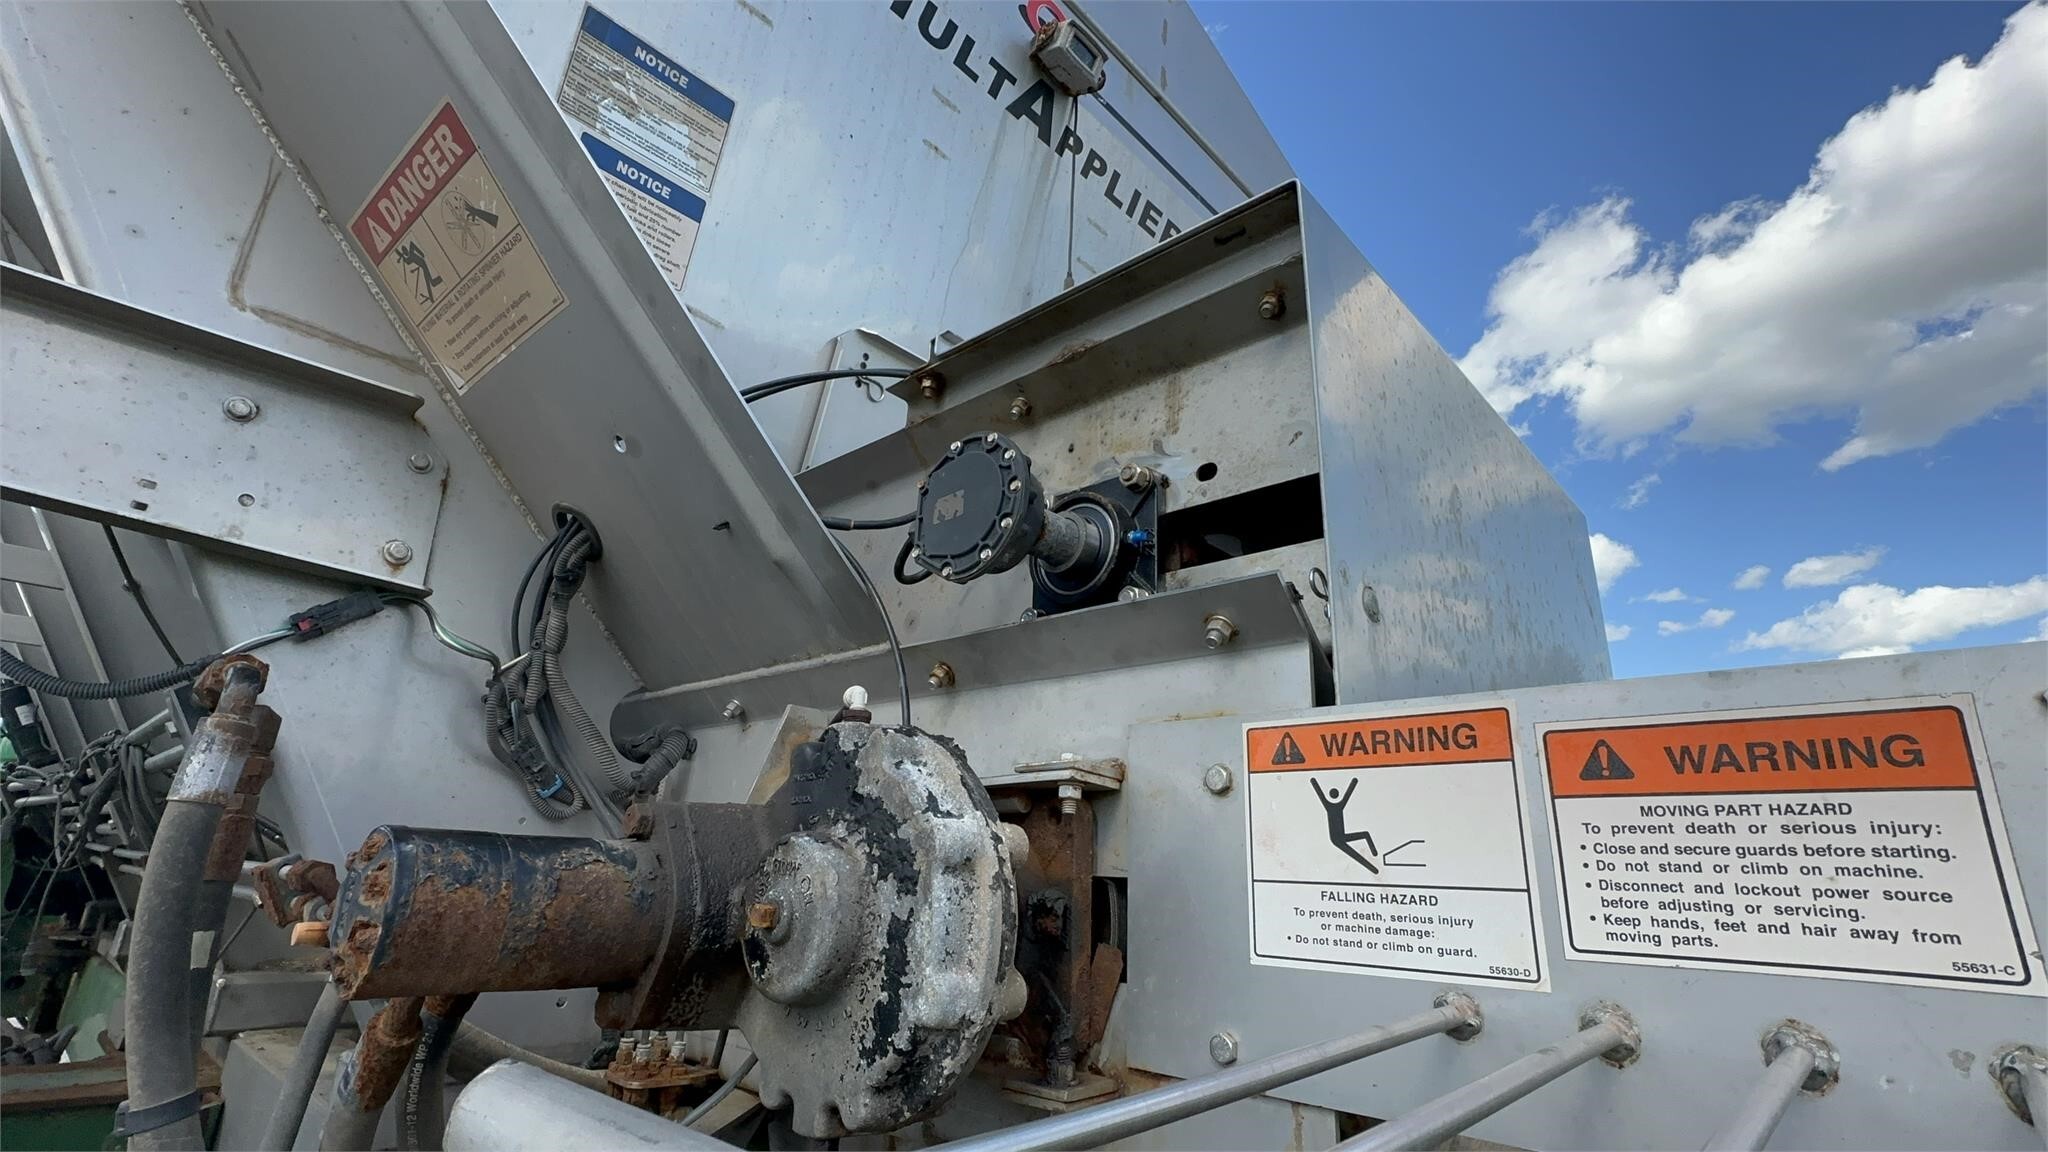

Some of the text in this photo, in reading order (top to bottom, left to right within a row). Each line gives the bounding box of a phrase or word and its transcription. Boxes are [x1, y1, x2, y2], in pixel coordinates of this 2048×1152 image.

[634, 46, 688, 88] NOTICE
[378, 124, 462, 231] DANGER
[615, 160, 670, 198] NOTICE
[611, 180, 626, 191] chain
[626, 188, 636, 197] life
[615, 191, 637, 205] periodic
[637, 211, 648, 219] and
[646, 224, 657, 233] and
[457, 273, 480, 297] ROTATING
[479, 253, 500, 276] SPINNER
[499, 232, 521, 256] HAZARD
[1320, 723, 1478, 757] WARNING
[1664, 734, 1924, 775] WARNING
[1640, 803, 1852, 817] MOVING PART HAZARD
[1582, 821, 1941, 838] To prevent death or serious injury:
[1593, 843, 1956, 862] Close and secure guards before starting.
[1596, 860, 1923, 878] Do not stand or climb on machine.
[1321, 891, 1438, 906] FALLING HAZARD
[1599, 879, 1952, 903] Disconnect and lockout power source
[1294, 907, 1473, 928] To prevent death, serious injury
[1601, 896, 1865, 922] before adjusting or servicing.
[1336, 924, 1381, 934] machine
[1385, 926, 1434, 939] damage:
[1604, 914, 1961, 945] Keep hands, feet and hair away from
[1296, 935, 1309, 944] Do
[1333, 939, 1362, 948] stand
[1382, 942, 1413, 952] climb
[1418, 946, 1432, 954] on
[1437, 948, 1476, 957] guard.
[1606, 931, 1718, 948] moving parts.
[1489, 966, 1531, 977] 55630-D
[1952, 962, 2015, 976] 55631-C
[406, 1062, 424, 1113] Worldwide
